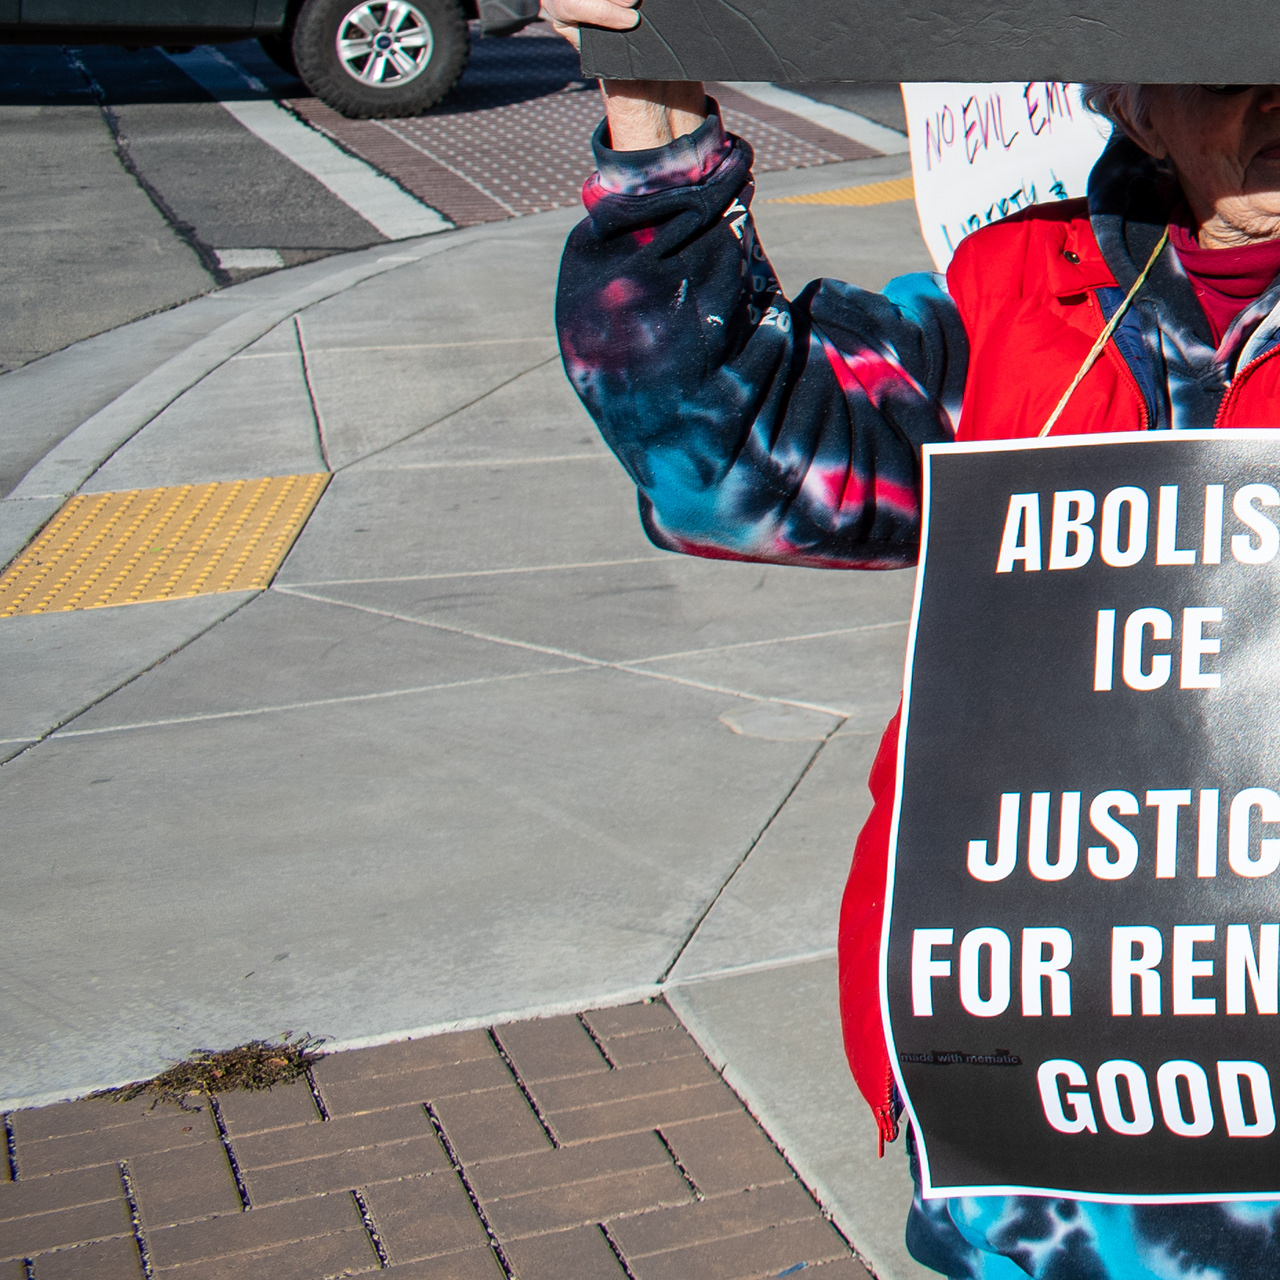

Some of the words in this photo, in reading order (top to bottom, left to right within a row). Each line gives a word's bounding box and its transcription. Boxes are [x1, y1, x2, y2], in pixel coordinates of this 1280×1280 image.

[926, 104, 955, 170] NO
[962, 92, 1019, 164] EVIL
[1094, 607, 1223, 691] ICE
[911, 927, 1073, 1017] FOR
[900, 1054, 934, 1062] made
[937, 1053, 962, 1063] with
[1036, 1059, 1276, 1137] GOOD
